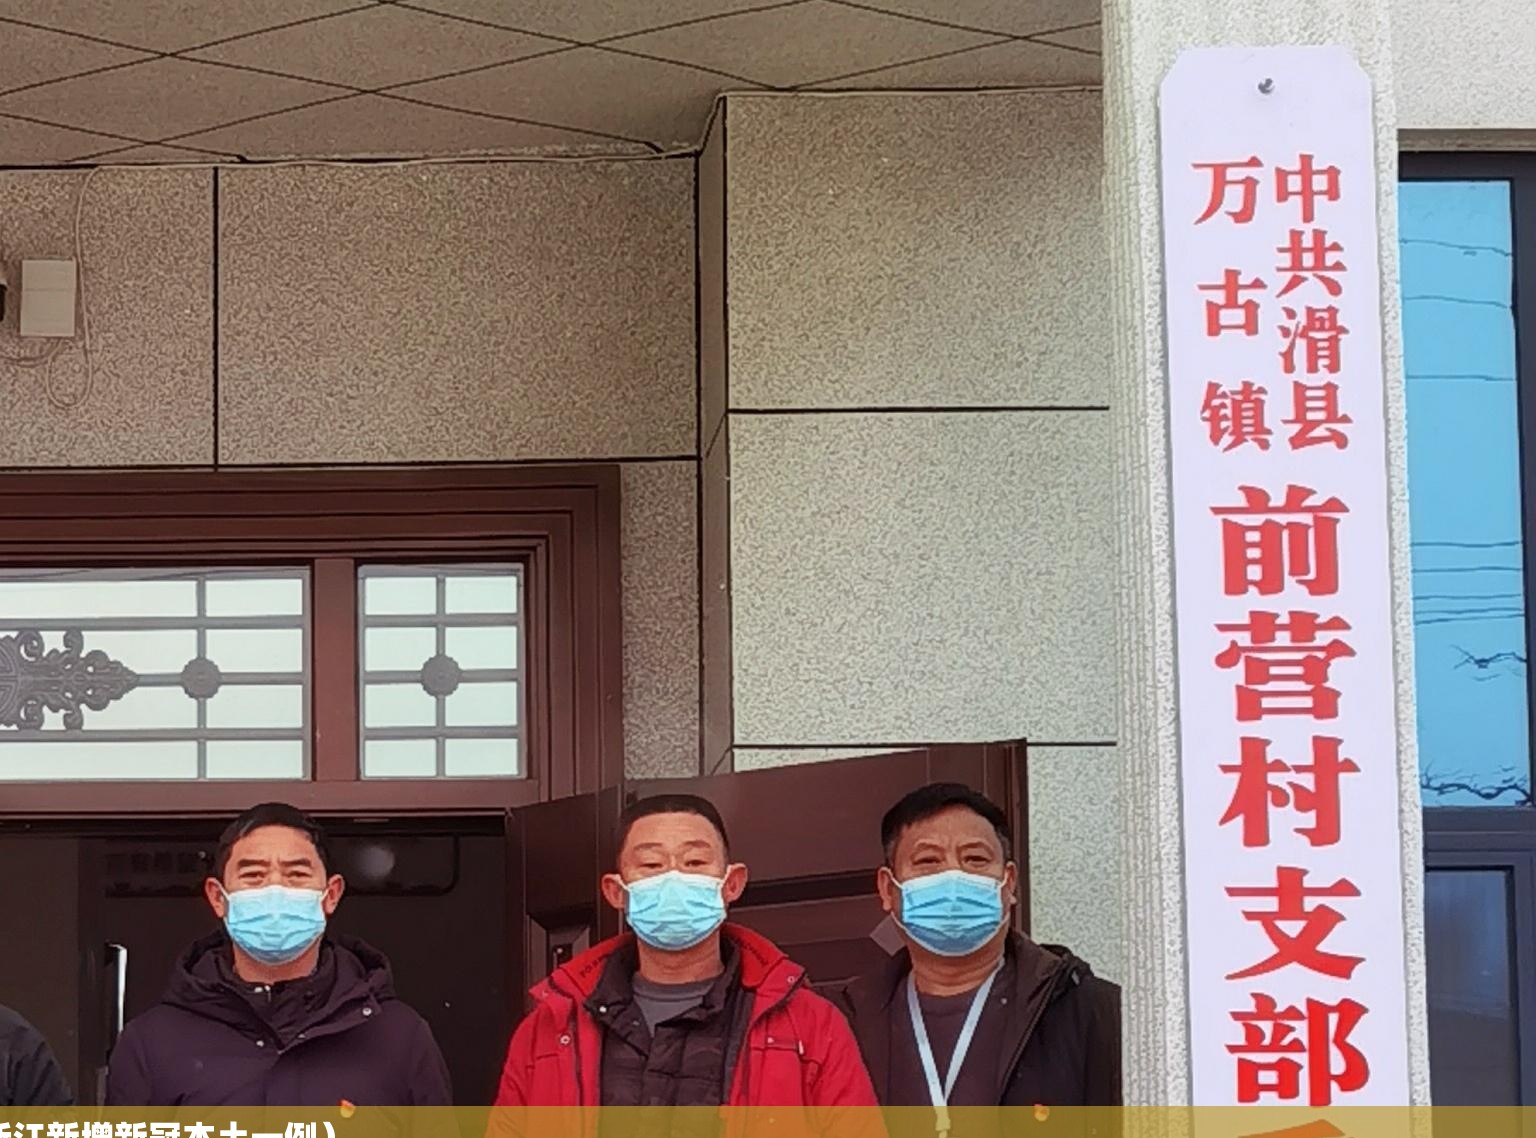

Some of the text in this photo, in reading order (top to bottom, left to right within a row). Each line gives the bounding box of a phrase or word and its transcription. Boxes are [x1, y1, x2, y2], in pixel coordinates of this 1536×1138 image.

[1192, 156, 1274, 452] 万古镇
[1275, 155, 1352, 452] 中共滑县
